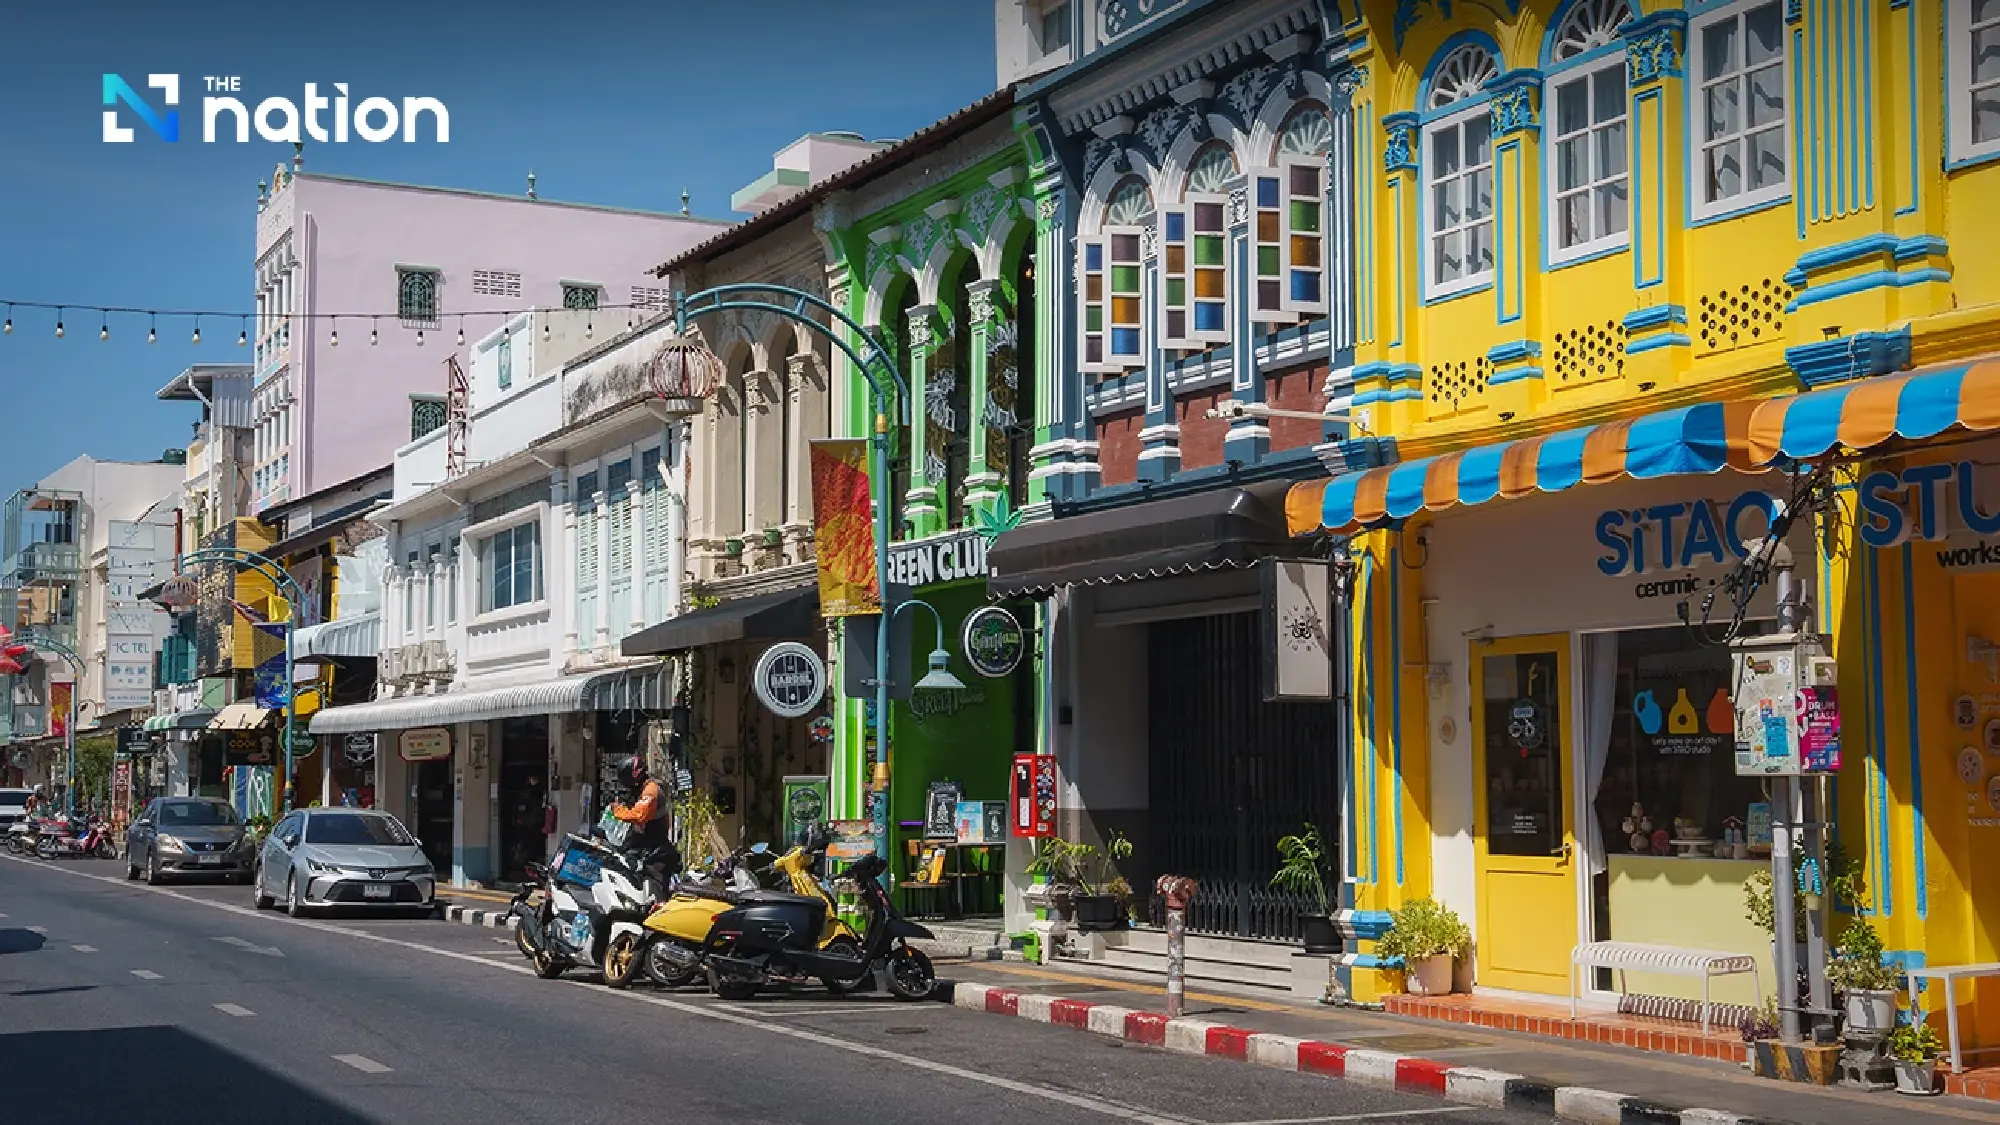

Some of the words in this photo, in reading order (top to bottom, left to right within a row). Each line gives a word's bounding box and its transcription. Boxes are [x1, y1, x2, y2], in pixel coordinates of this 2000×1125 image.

[886, 545, 933, 586] REEN
[1636, 573, 1701, 598] ceramic
[1808, 701, 1836, 710] DRUM
